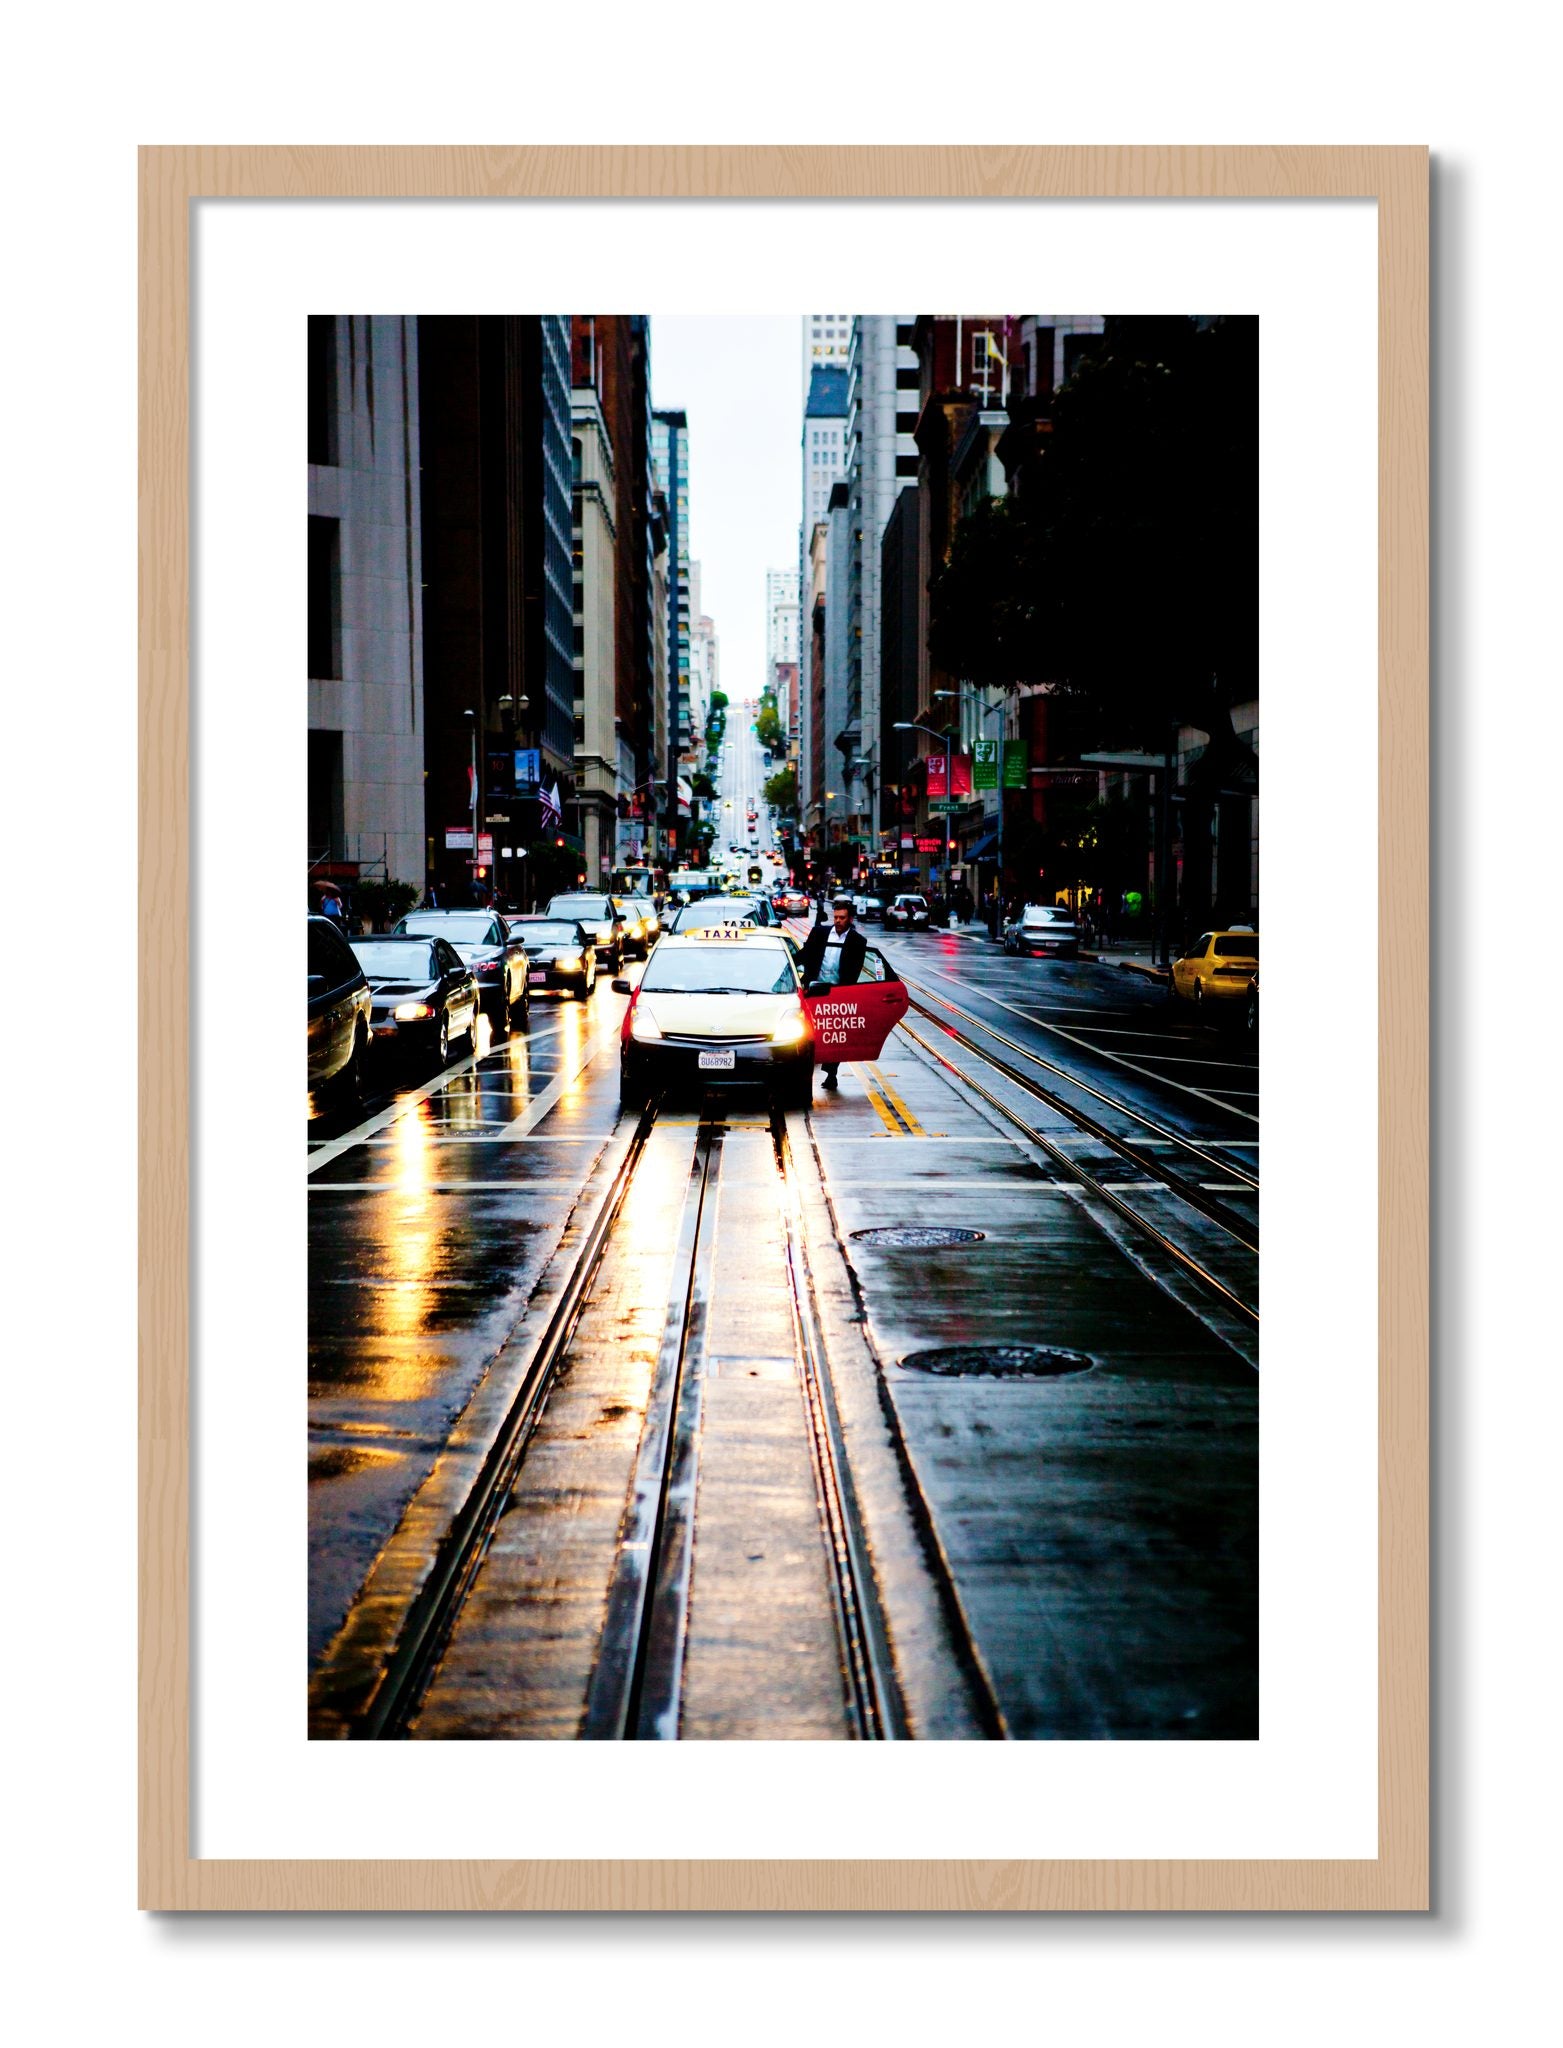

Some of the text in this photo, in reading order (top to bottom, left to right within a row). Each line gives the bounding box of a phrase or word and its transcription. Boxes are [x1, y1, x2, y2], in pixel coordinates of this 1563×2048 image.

[703, 930, 738, 938] TAXI
[814, 1003, 858, 1016] ARROW
[822, 1031, 847, 1044] CAB
